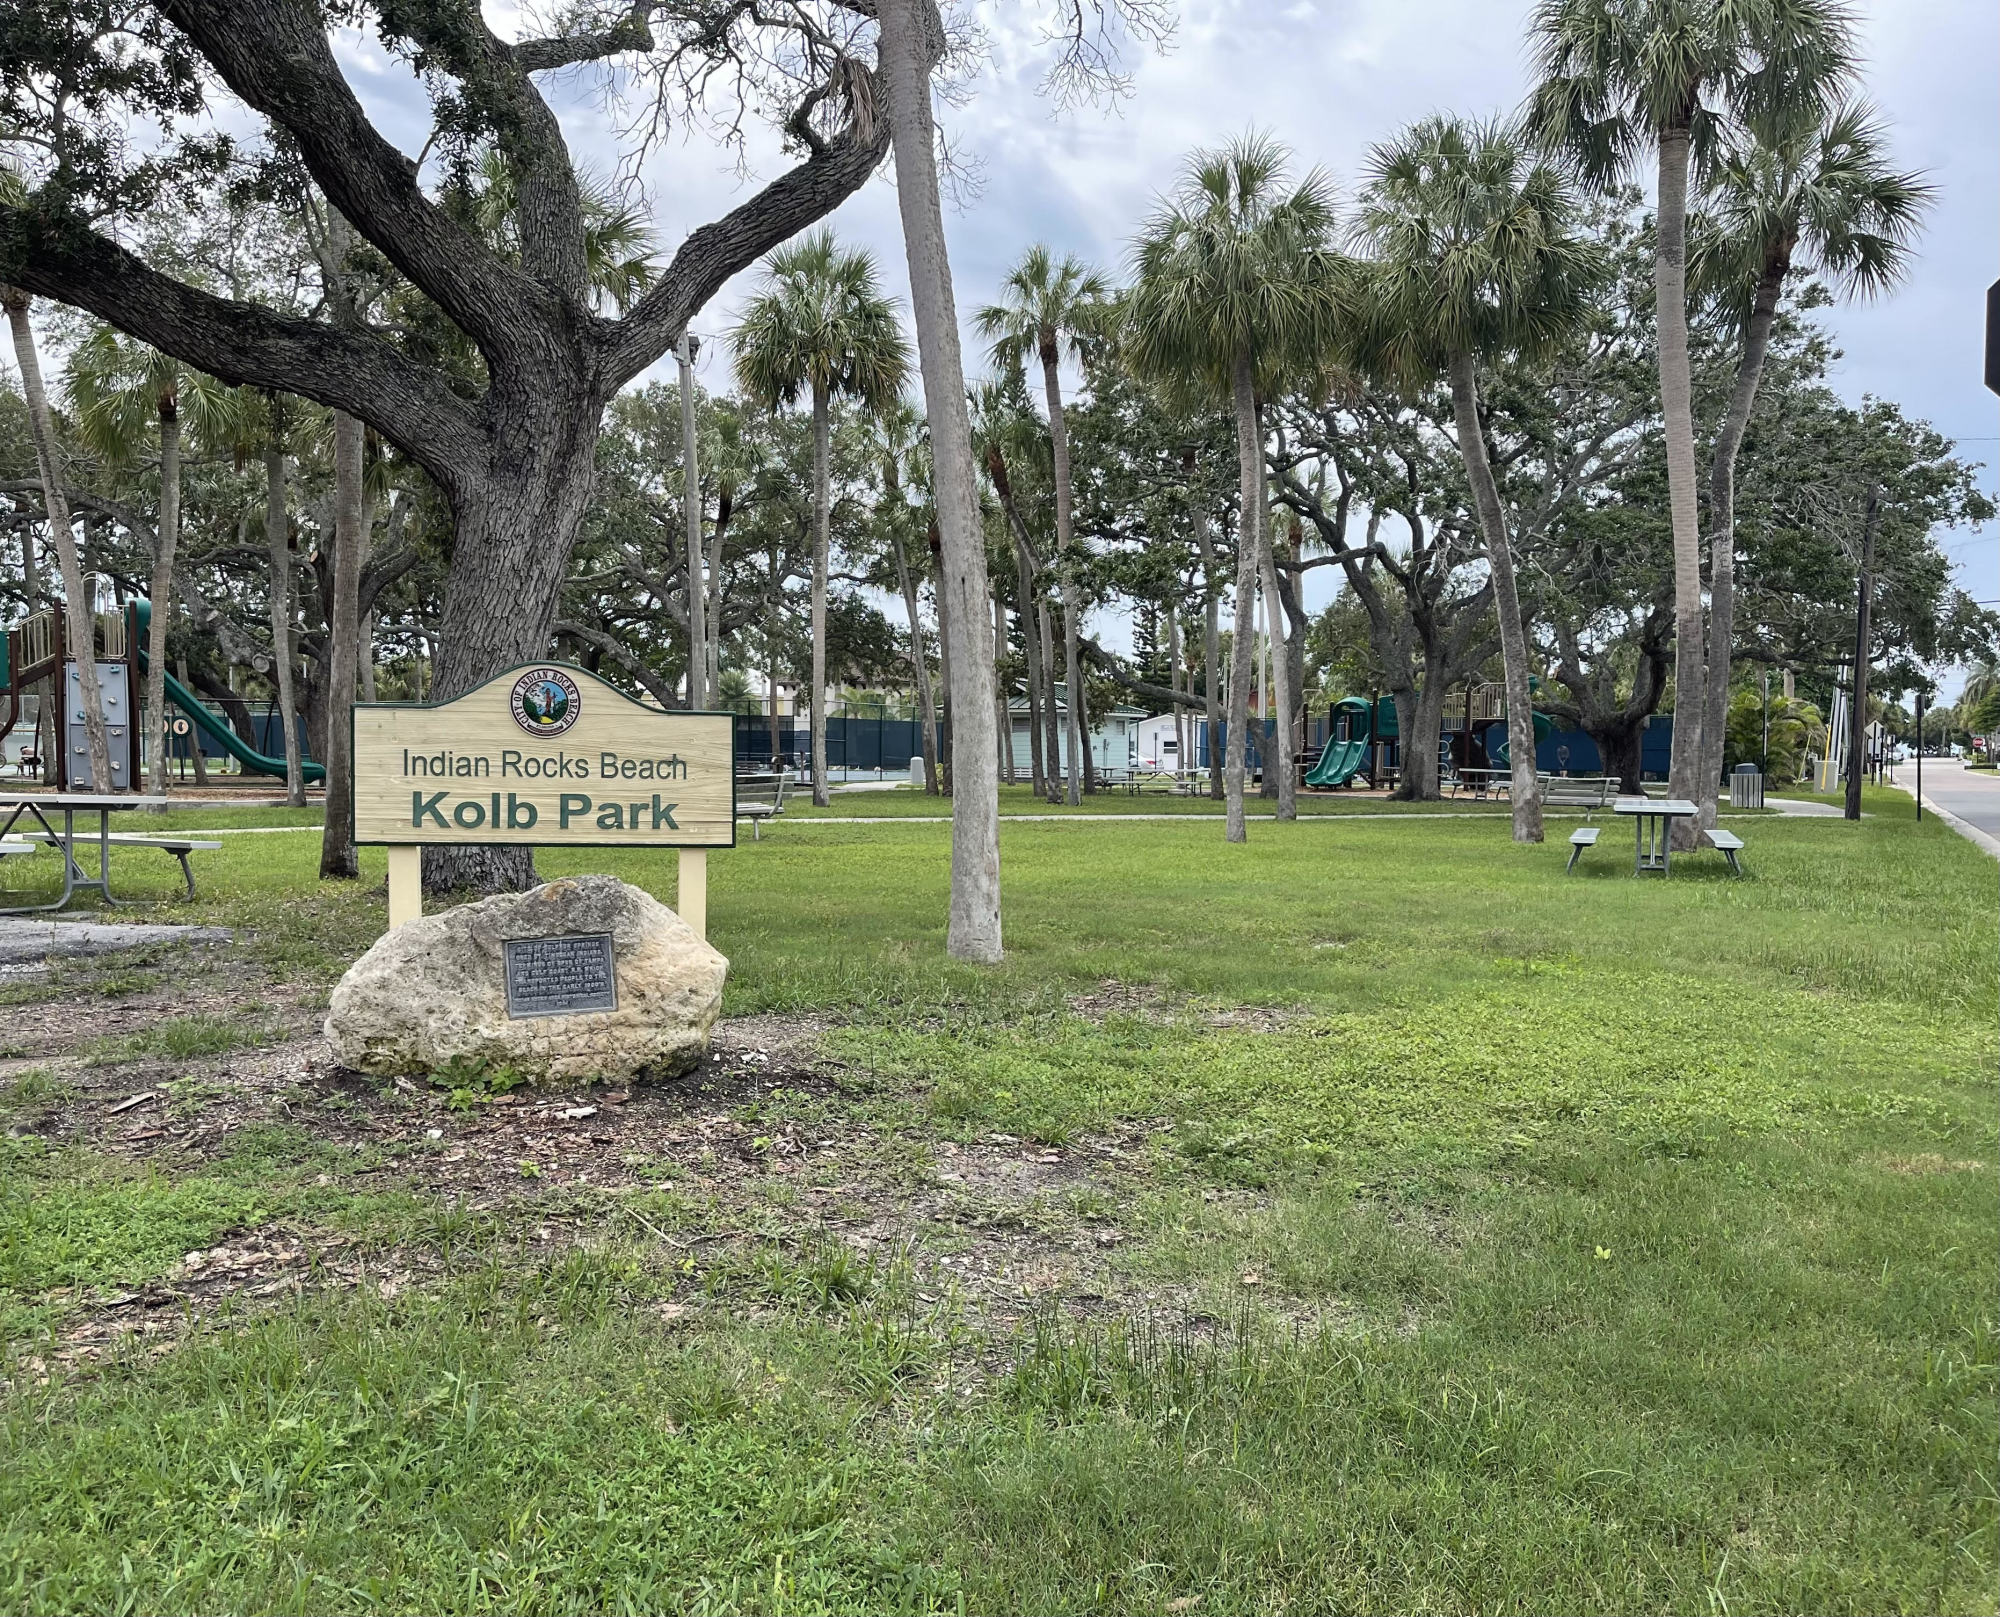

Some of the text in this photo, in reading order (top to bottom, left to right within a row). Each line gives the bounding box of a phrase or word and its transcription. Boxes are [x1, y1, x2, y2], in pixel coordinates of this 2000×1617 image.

[514, 671, 577, 725] CITY OF INDIAN ROCKS BEACH
[403, 749, 687, 779] Indian Rocks Beach
[413, 791, 679, 829] Kolb Park
